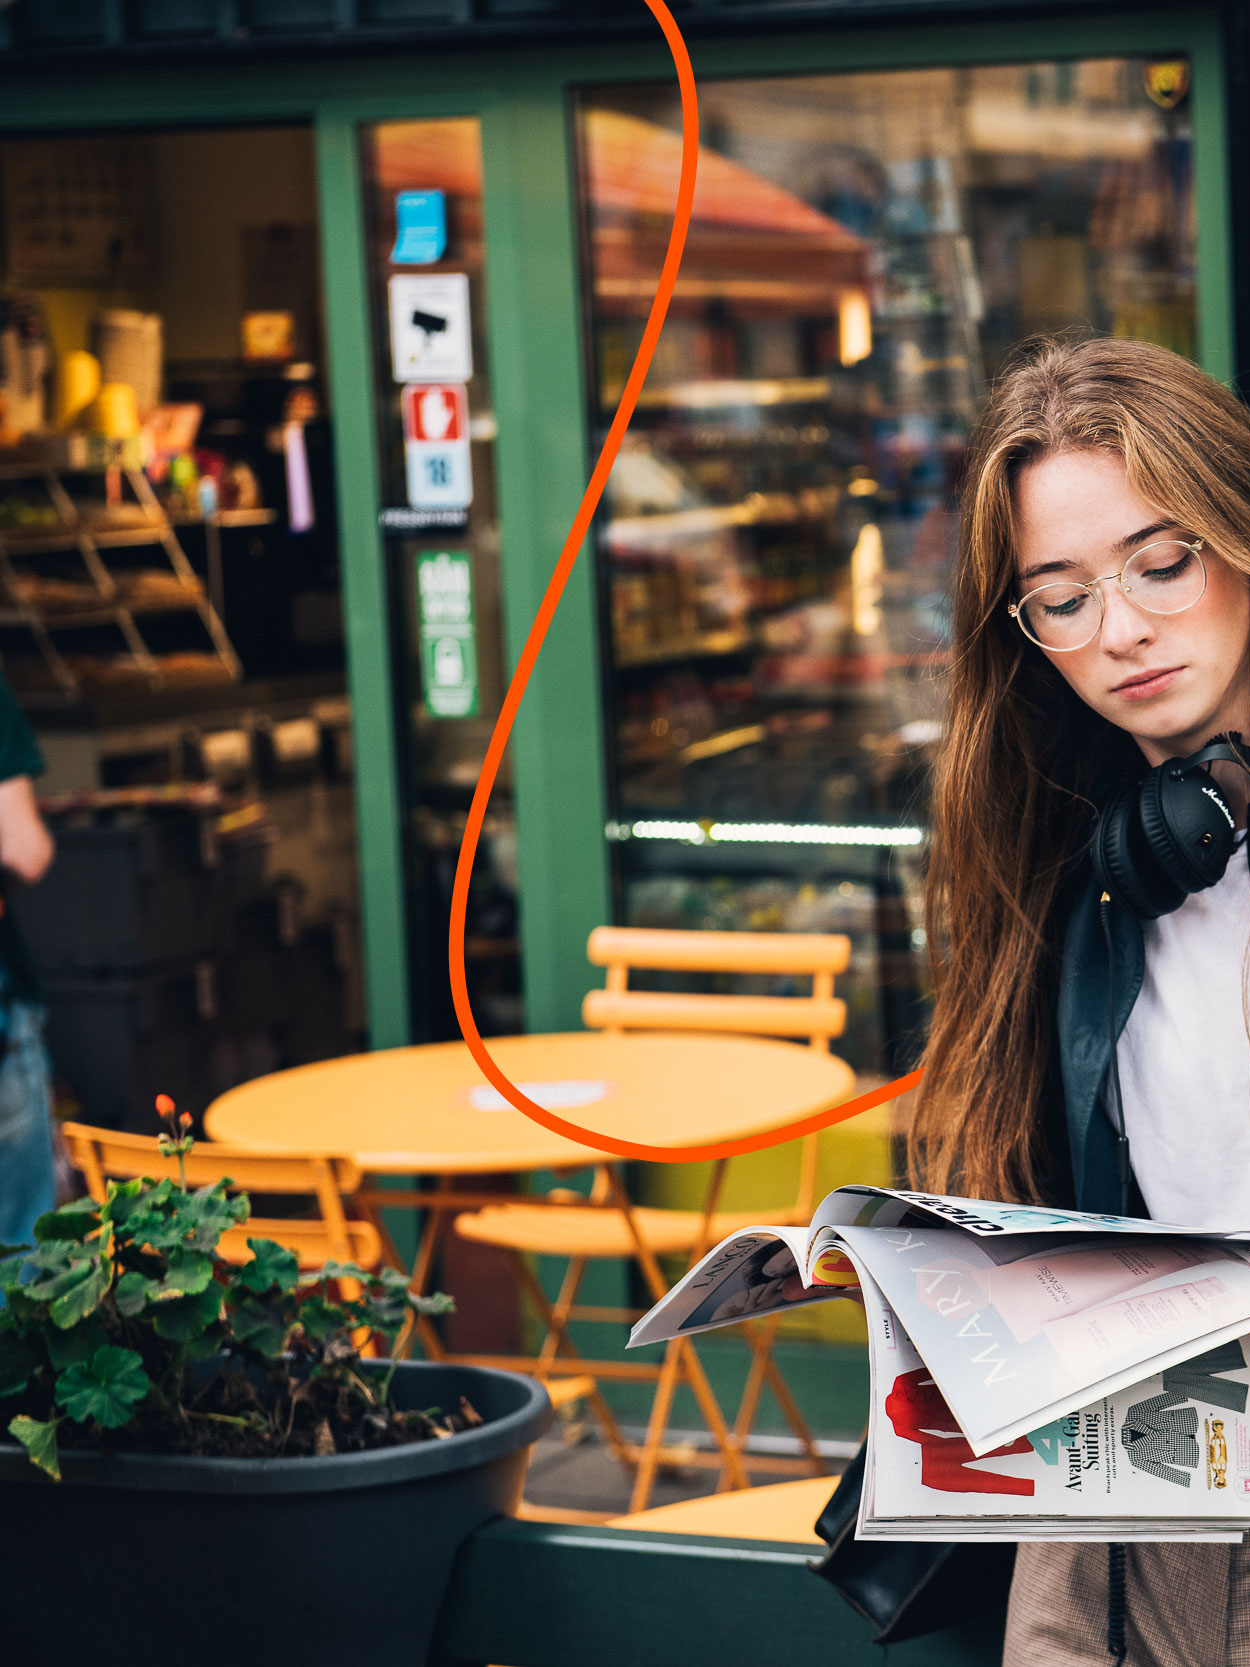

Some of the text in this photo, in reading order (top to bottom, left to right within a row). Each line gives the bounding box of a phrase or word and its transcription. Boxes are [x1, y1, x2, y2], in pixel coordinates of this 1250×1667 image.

[1037, 1264, 1075, 1306] TIMEWISE
[883, 1319, 891, 1340] STYLE
[910, 1267, 1018, 1389] MARY
[1082, 1412, 1101, 1471] Suiting
